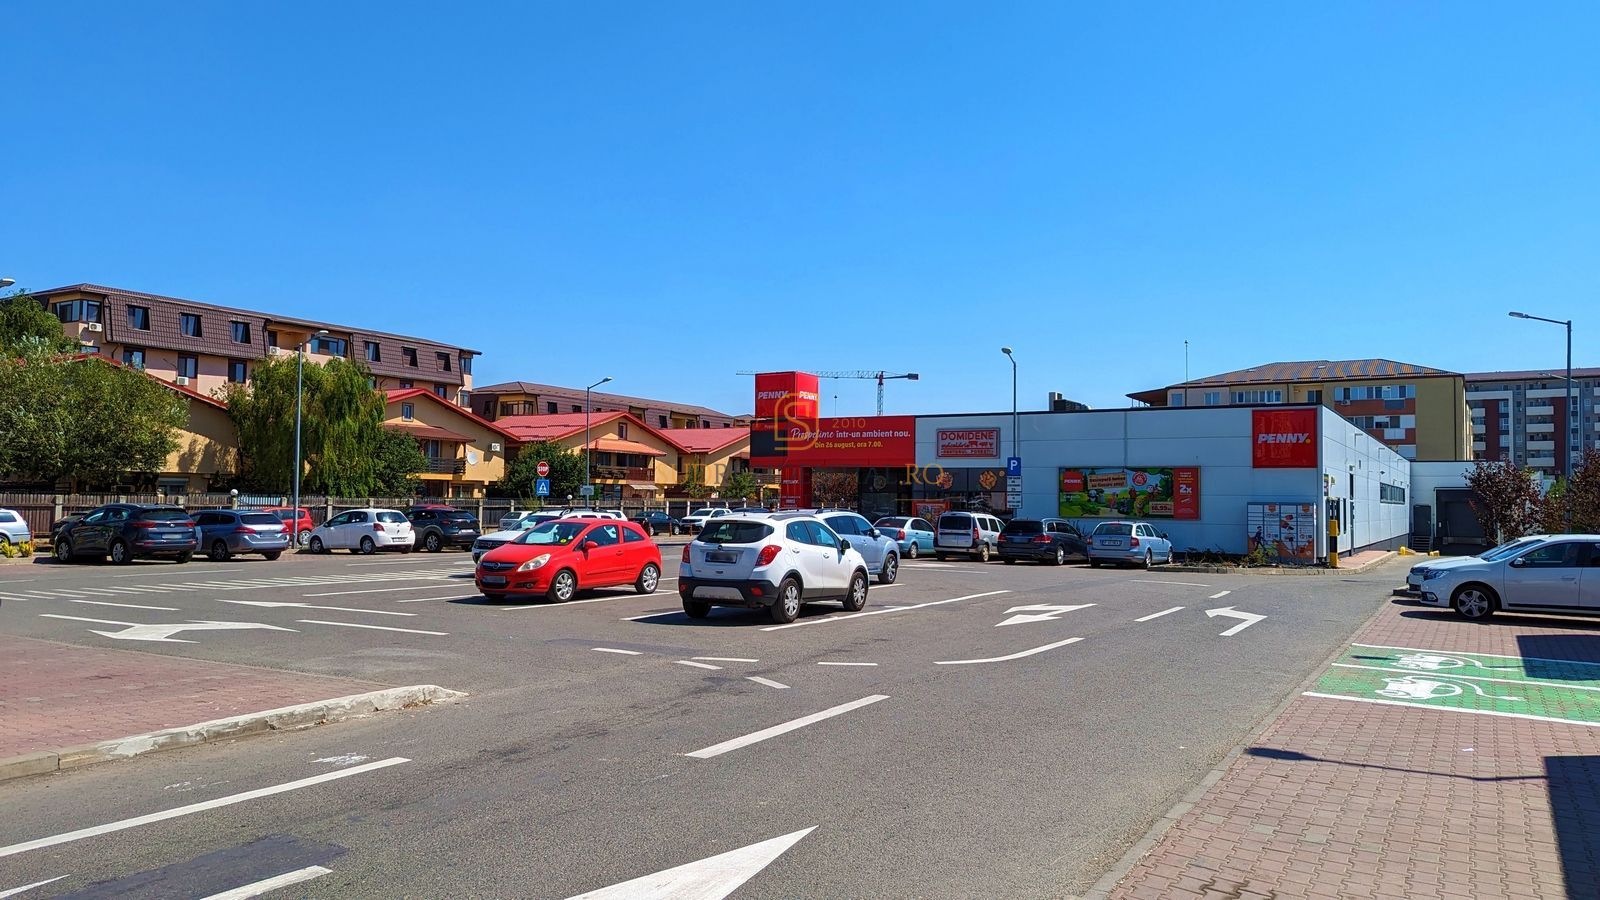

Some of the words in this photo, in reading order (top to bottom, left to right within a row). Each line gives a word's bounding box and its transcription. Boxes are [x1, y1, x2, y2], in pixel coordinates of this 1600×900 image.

[836, 430, 861, 438] într-un
[941, 431, 994, 440] DOMIDENE
[1010, 459, 1018, 470] P
[1179, 484, 1193, 494] 2x
